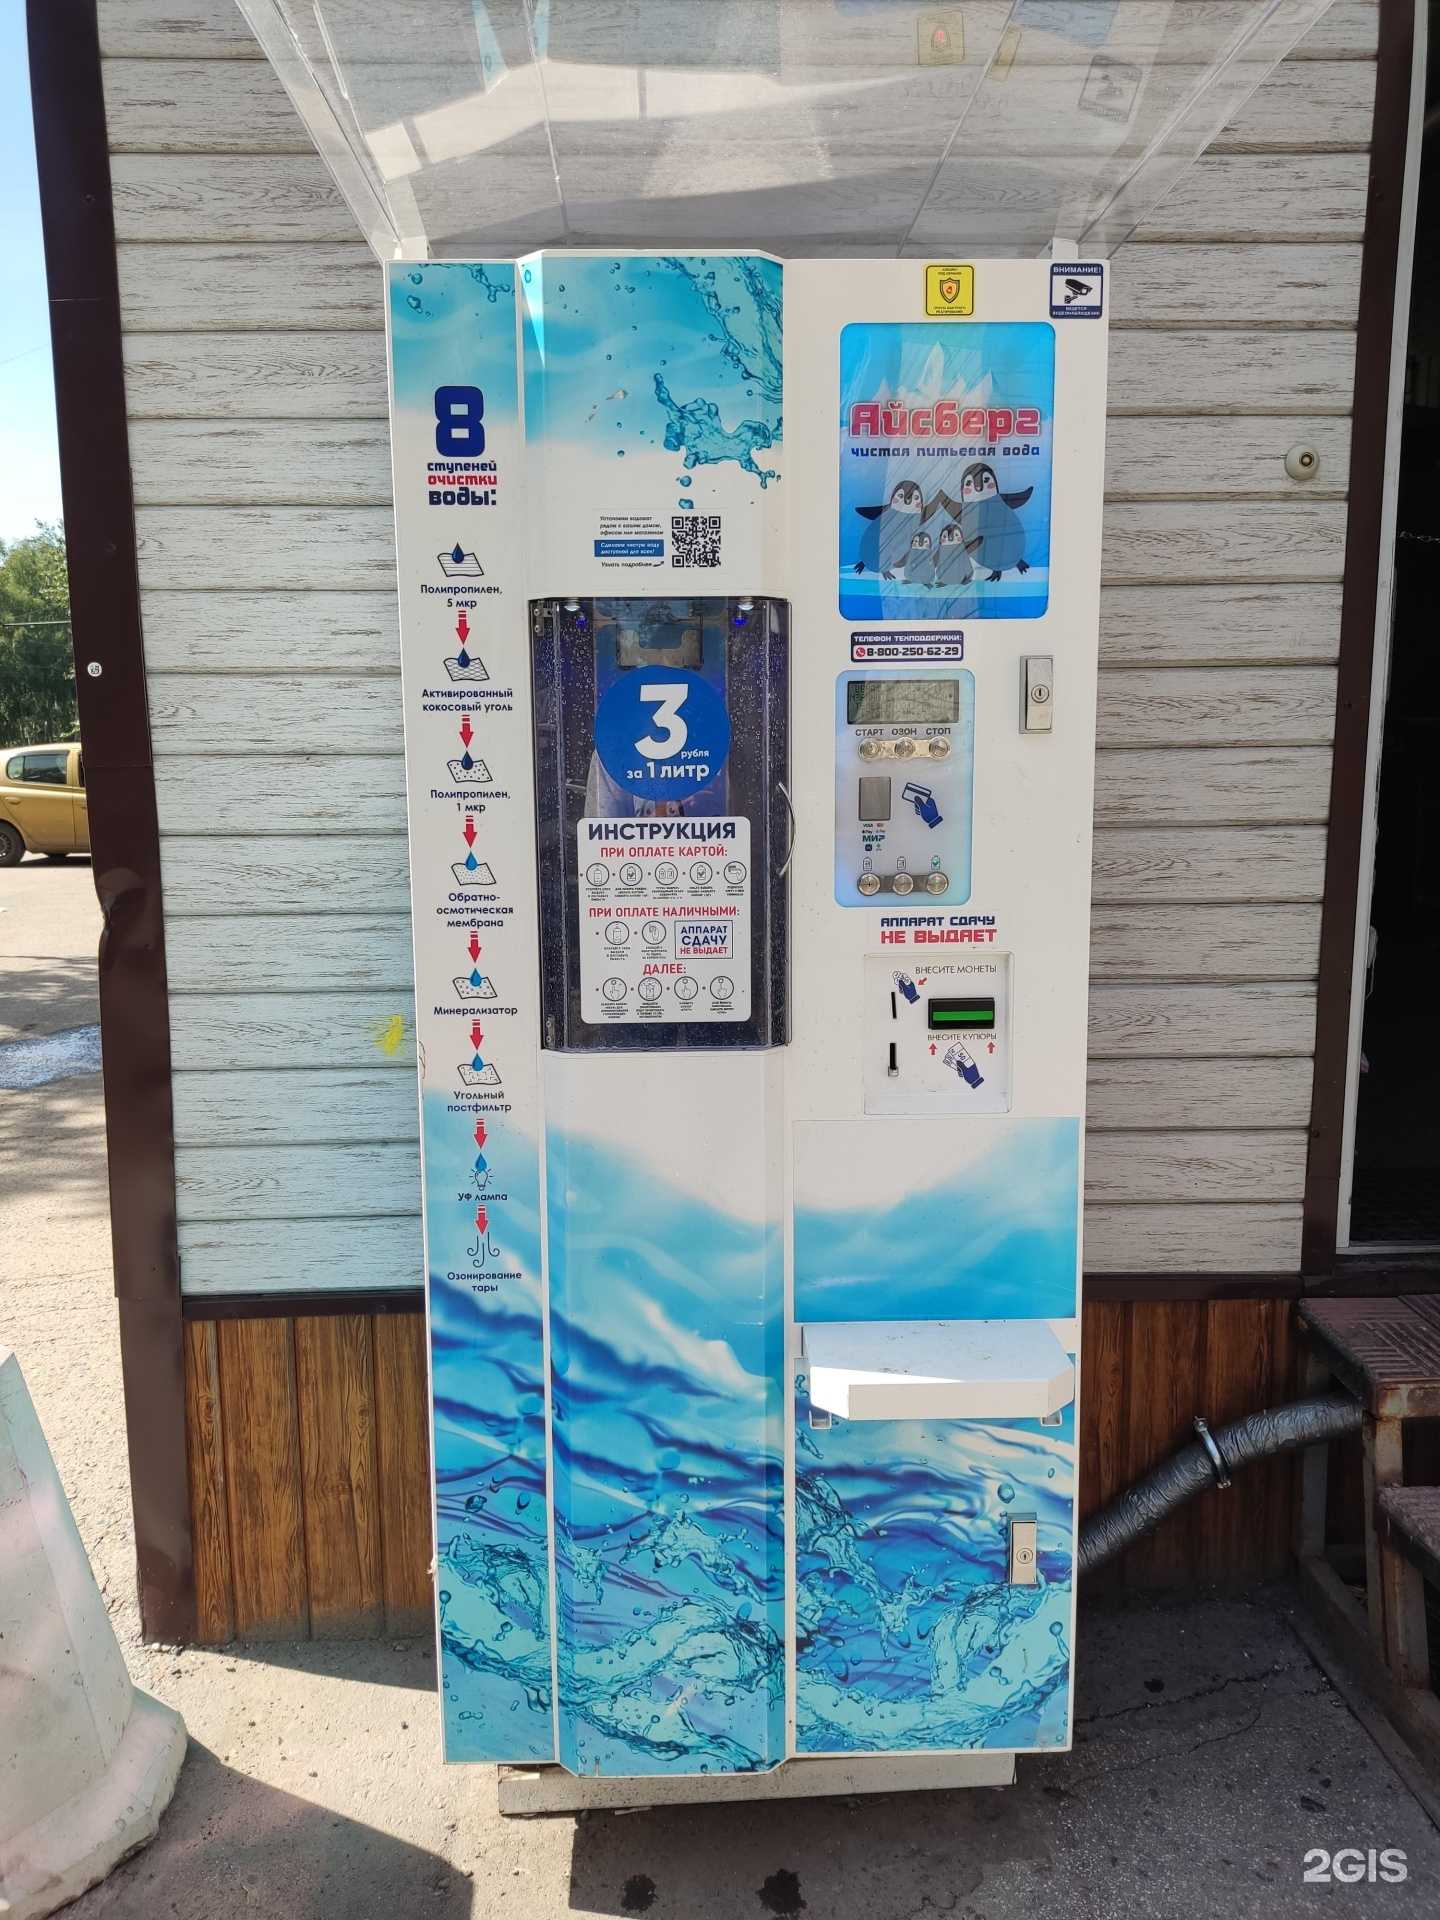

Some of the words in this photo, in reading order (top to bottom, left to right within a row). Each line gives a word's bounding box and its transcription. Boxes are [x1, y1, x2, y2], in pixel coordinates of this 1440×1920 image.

[435, 386, 485, 457] 8
[850, 400, 1041, 445] Айсберг
[851, 447, 910, 457] чистая
[916, 447, 996, 457] питьевая
[1002, 444, 1041, 456] вода
[427, 460, 497, 473] ступеней
[428, 475, 497, 485] очистки
[429, 487, 496, 505] воды:
[420, 585, 503, 595] Полипропилен,
[447, 599, 453, 608] 5
[456, 600, 477, 609] мкр
[854, 635, 892, 643] ТЕЛЕФОН
[894, 634, 962, 642] ТЕХПОДДЕРЖКИ:
[867, 646, 959, 656] 8-800-250-62-29
[422, 688, 513, 699] Активированный
[423, 702, 481, 711] кокосовый
[484, 703, 513, 713] уголь
[634, 683, 689, 760] 3
[855, 728, 884, 736] СТАРТ
[891, 728, 917, 736] ОЗОН
[926, 727, 951, 735] СТОП
[681, 749, 710, 759] рубля
[626, 770, 643, 779] за
[646, 762, 655, 778] 1
[660, 764, 710, 781] литр
[430, 789, 511, 800] Полипропилен,
[457, 803, 461, 811] 1
[465, 804, 486, 813] мкр
[588, 822, 736, 842] ИНСТРУКЦИЯ
[600, 848, 625, 858] ПРИ
[628, 846, 675, 857] ОПЛАТЕ
[678, 844, 728, 857] КАРТОЙ:
[448, 893, 500, 903] Обратно-
[589, 907, 612, 918] ПРИ
[615, 907, 659, 917] ОПЛАТЕ
[662, 906, 741, 917] НАЛИЧНЫМИ:
[447, 919, 504, 928] мембрана
[880, 917, 945, 927] АППАРАТ
[949, 916, 995, 926] СДАЧУ
[680, 926, 728, 934] АППАРАТ
[681, 936, 727, 946] СДАЧУ
[881, 931, 906, 944] НЕ
[914, 929, 997, 943] ВЫДАЕТ
[680, 947, 691, 955] НЕ
[693, 947, 728, 955] ВЫДАЕТ
[642, 964, 688, 976] ДАЛЕЕ:
[915, 966, 957, 974] ВНЕСИТЕ
[957, 965, 997, 973] МОНЕТЫ
[433, 1006, 518, 1016] Минерализатор
[927, 1033, 961, 1041] ВНЕСИТЕ
[962, 1032, 997, 1040] КУПЮРЫ
[453, 1091, 505, 1100] Угольный
[447, 1103, 512, 1114] постфильтр
[458, 1193, 472, 1201] УФ
[447, 1272, 522, 1281] Озонирование
[472, 1285, 498, 1293] тары
